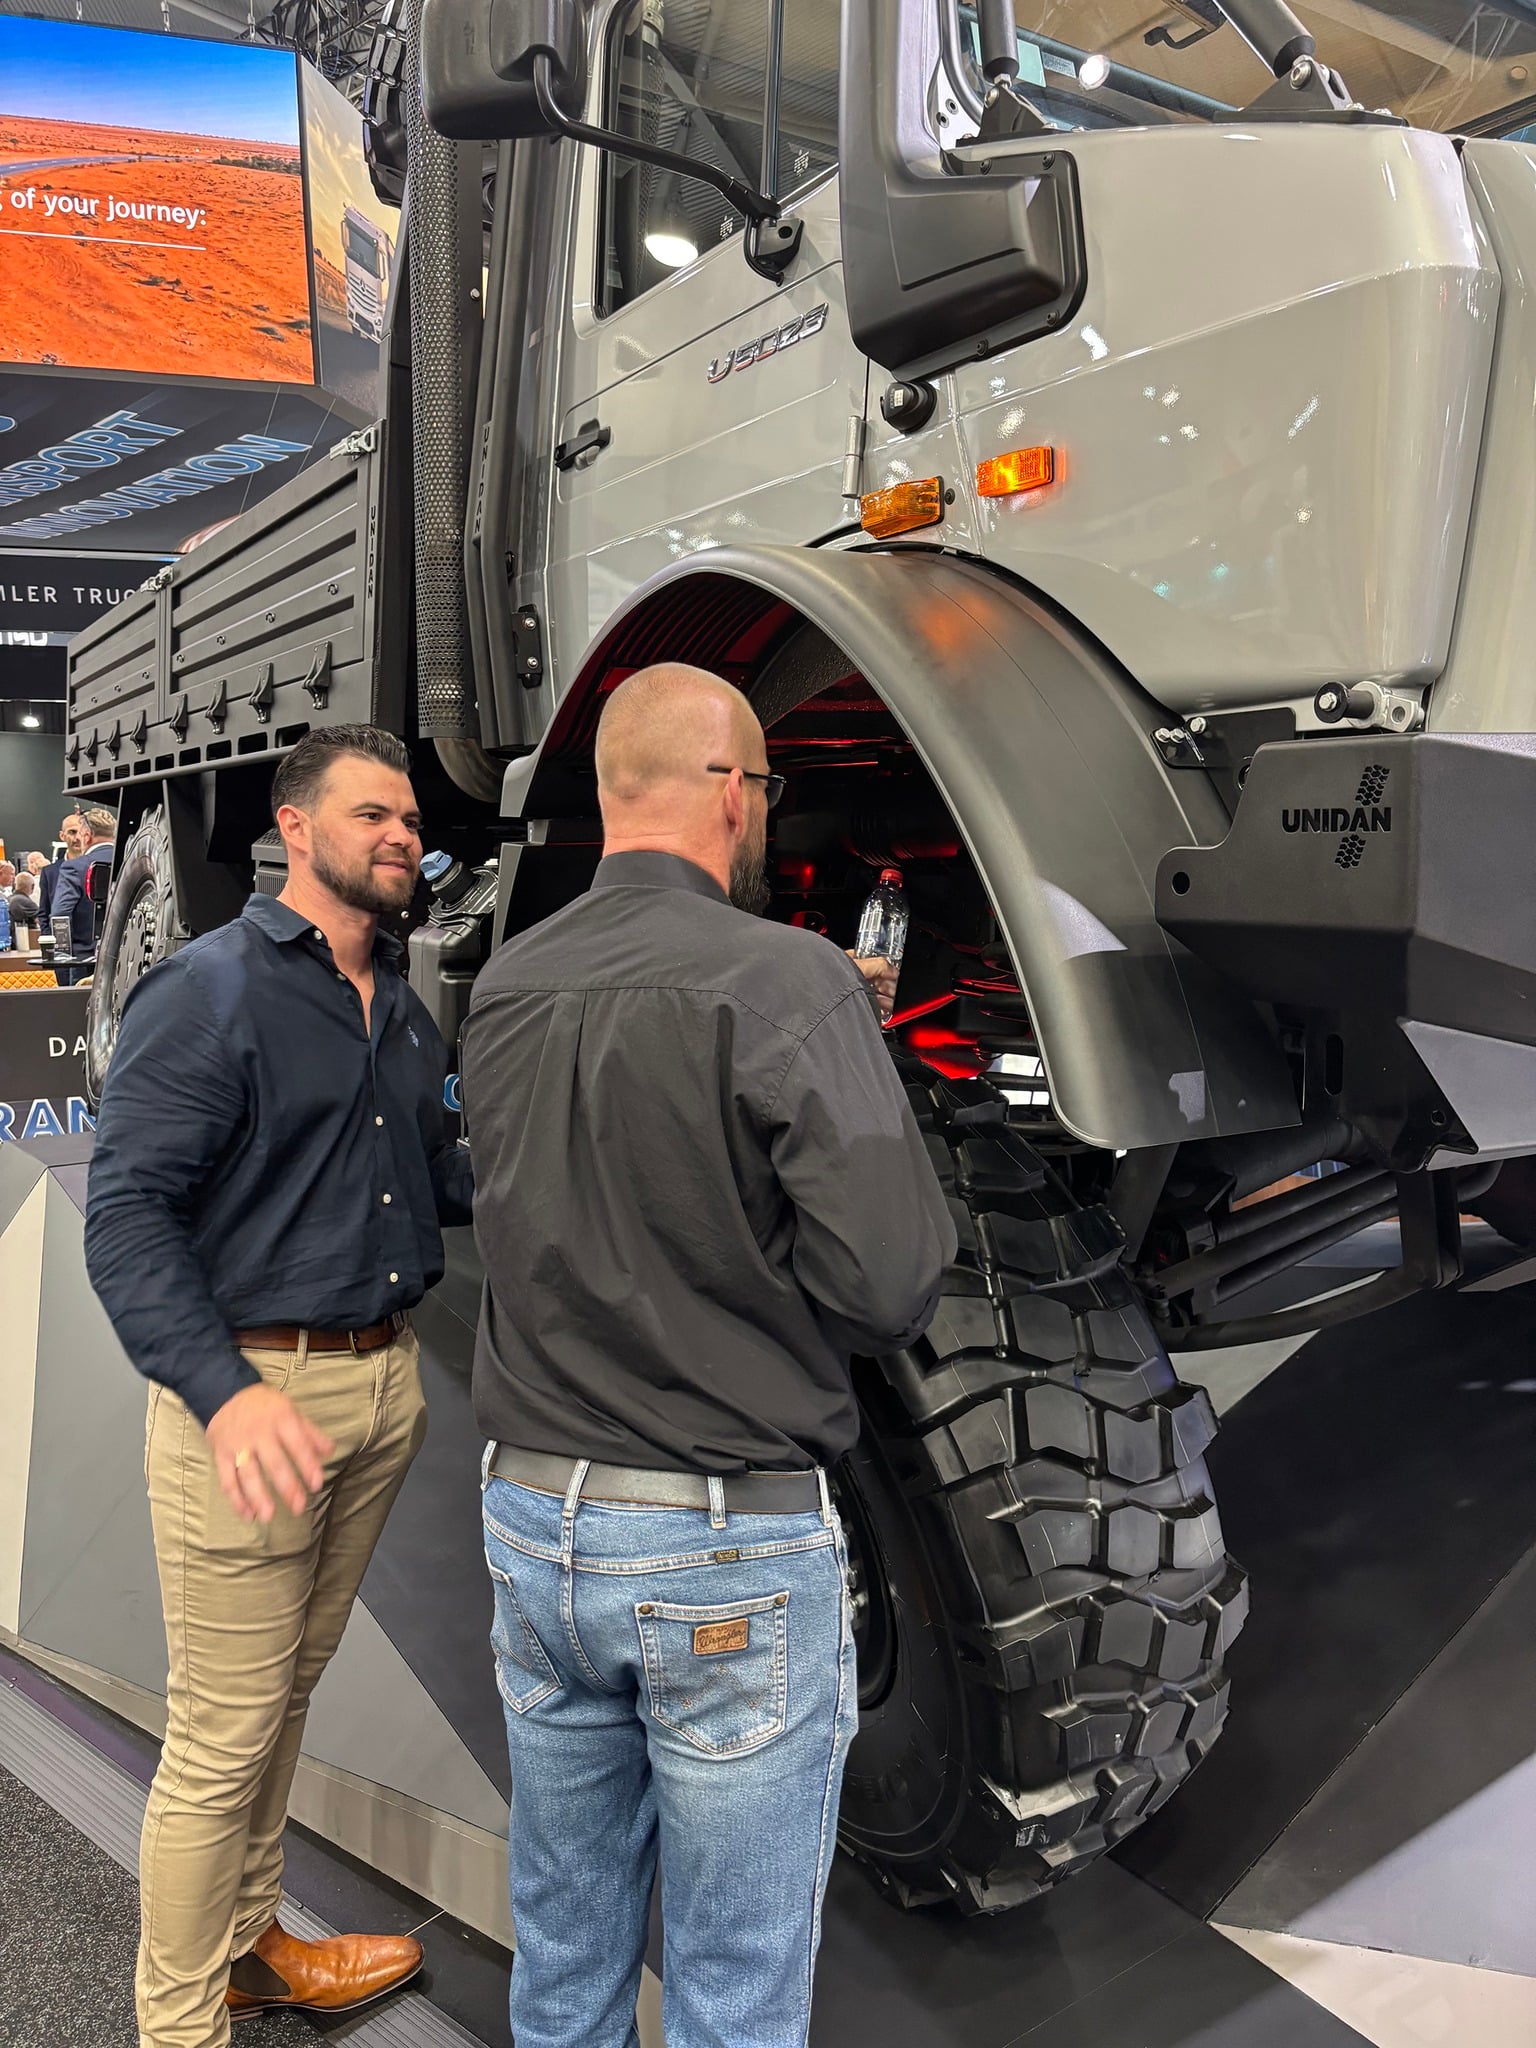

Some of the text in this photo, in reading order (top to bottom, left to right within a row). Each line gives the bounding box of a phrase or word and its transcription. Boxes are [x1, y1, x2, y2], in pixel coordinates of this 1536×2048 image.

[10, 187, 37, 210] of
[43, 194, 99, 217] your
[106, 195, 207, 229] journey:
[474, 427, 490, 533] UNIDAN
[367, 505, 377, 600] UNIDAN
[1281, 807, 1392, 834] UNIDAN
